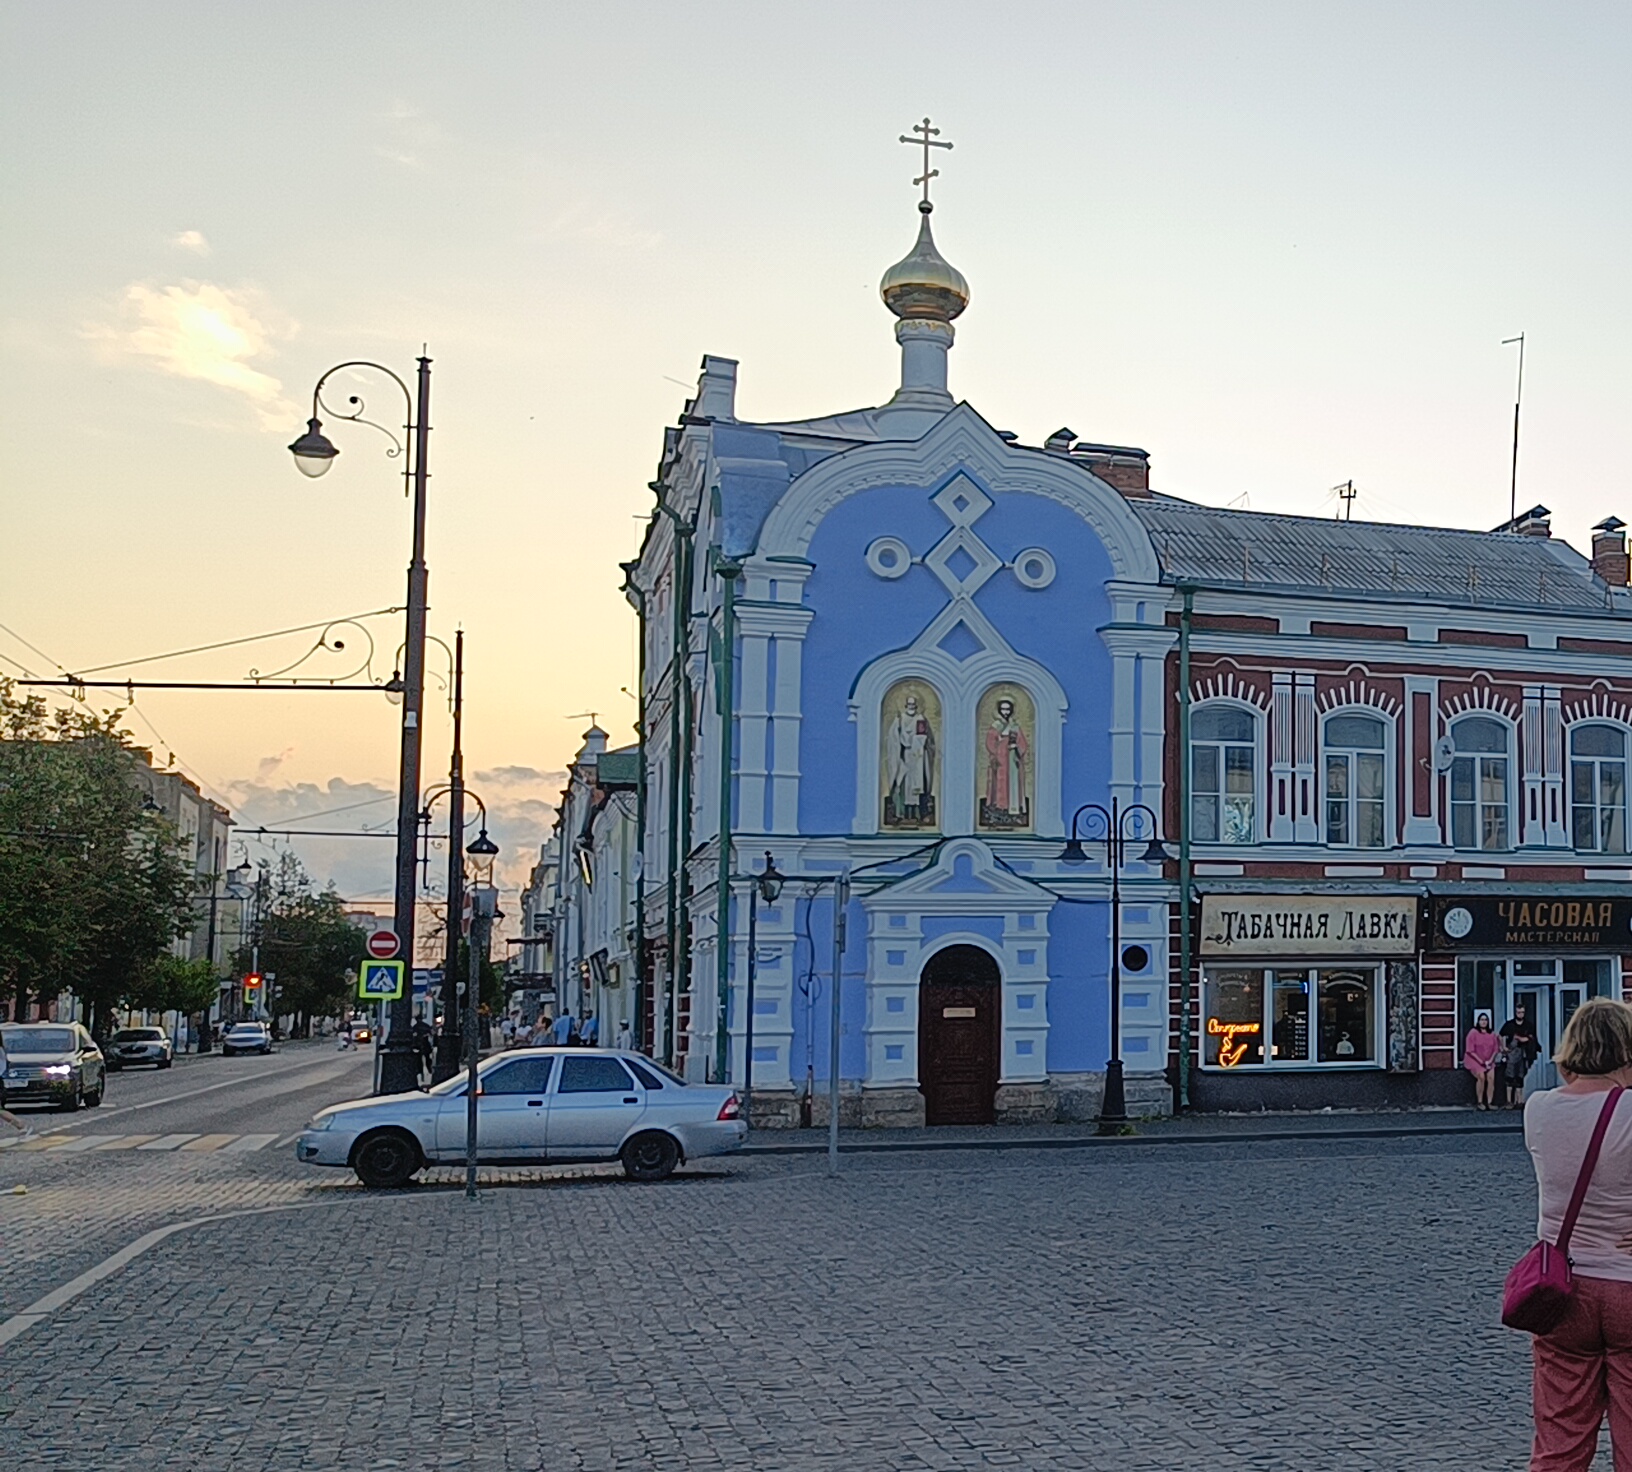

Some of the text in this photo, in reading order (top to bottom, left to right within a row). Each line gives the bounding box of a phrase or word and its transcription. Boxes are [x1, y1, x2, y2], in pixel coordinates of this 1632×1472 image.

[1498, 902, 1612, 927] ЧАСОВАЯ
[1205, 911, 1410, 945] ТАБАЧНАЯ ЛАВКА
[1505, 931, 1600, 943] МАСТЕРСКАЯ
